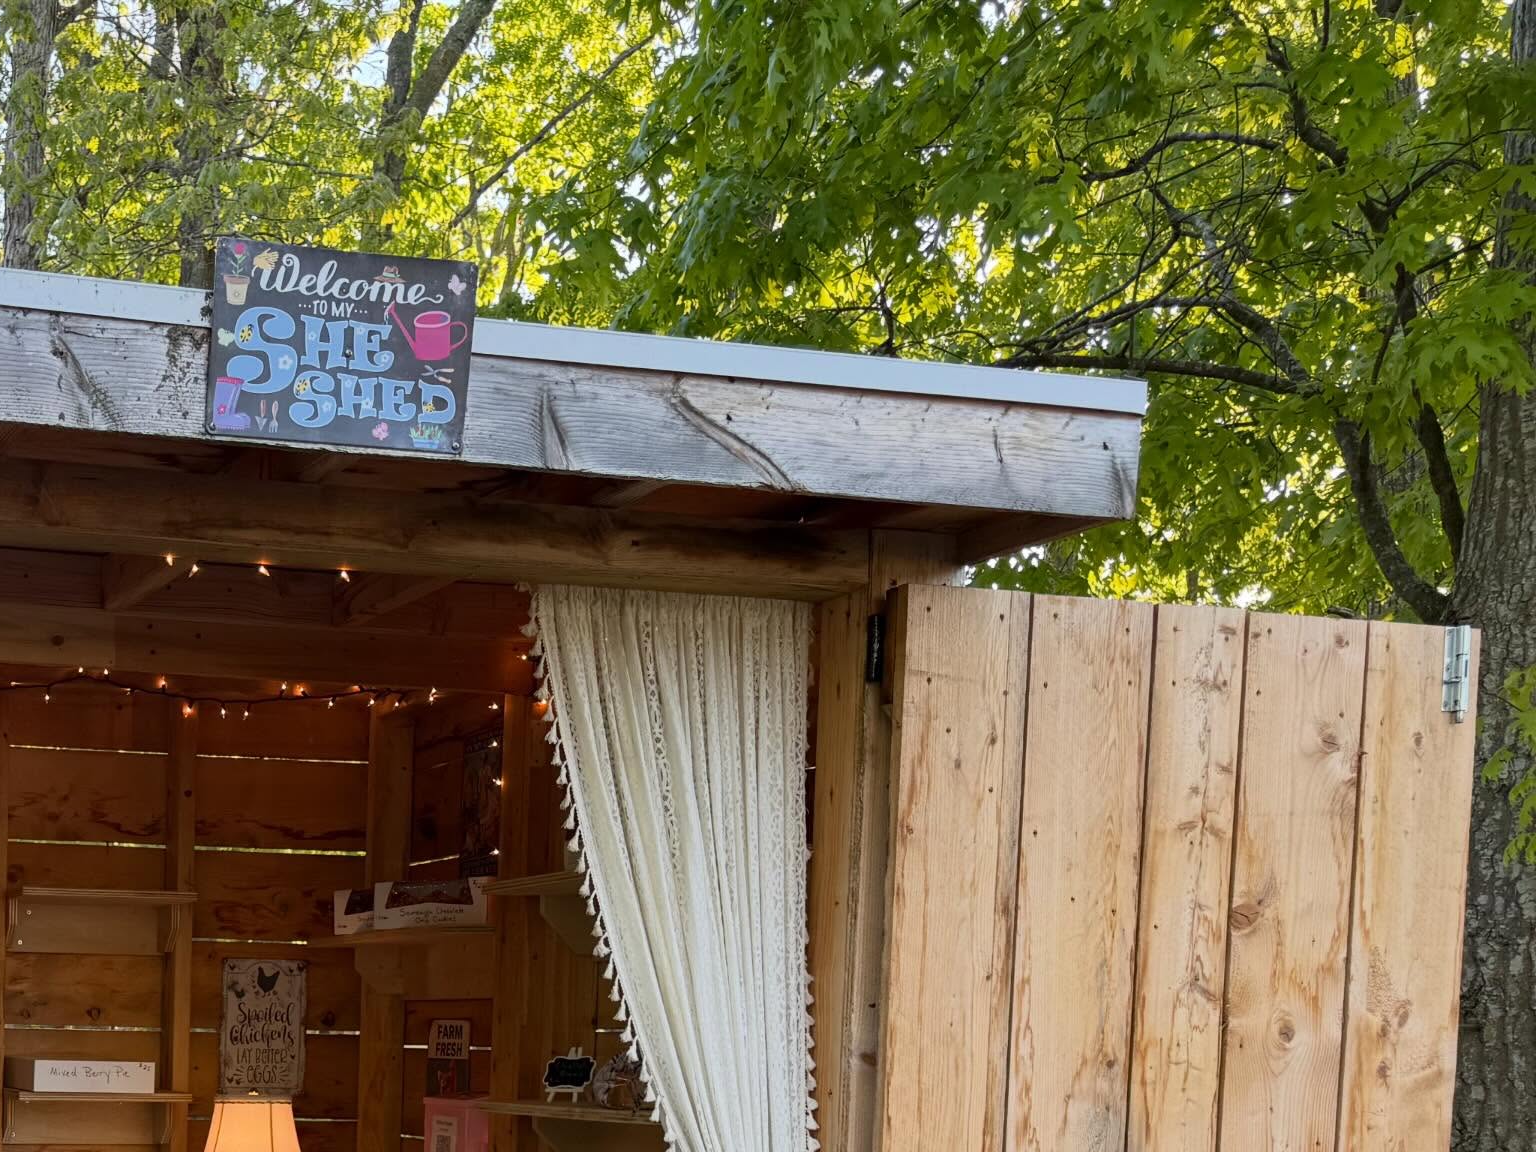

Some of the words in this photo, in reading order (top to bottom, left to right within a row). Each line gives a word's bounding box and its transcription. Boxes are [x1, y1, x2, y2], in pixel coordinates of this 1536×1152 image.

[251, 253, 443, 305] Welcome
[226, 306, 395, 394] SHE
[288, 370, 456, 428] SHED
[238, 1002, 296, 1026] Spoiled
[230, 1023, 296, 1048] Chickens
[437, 1024, 463, 1040] FARM
[435, 1042, 463, 1057] FRESH
[49, 1066, 77, 1078] Mixed
[82, 1066, 111, 1084] Berry
